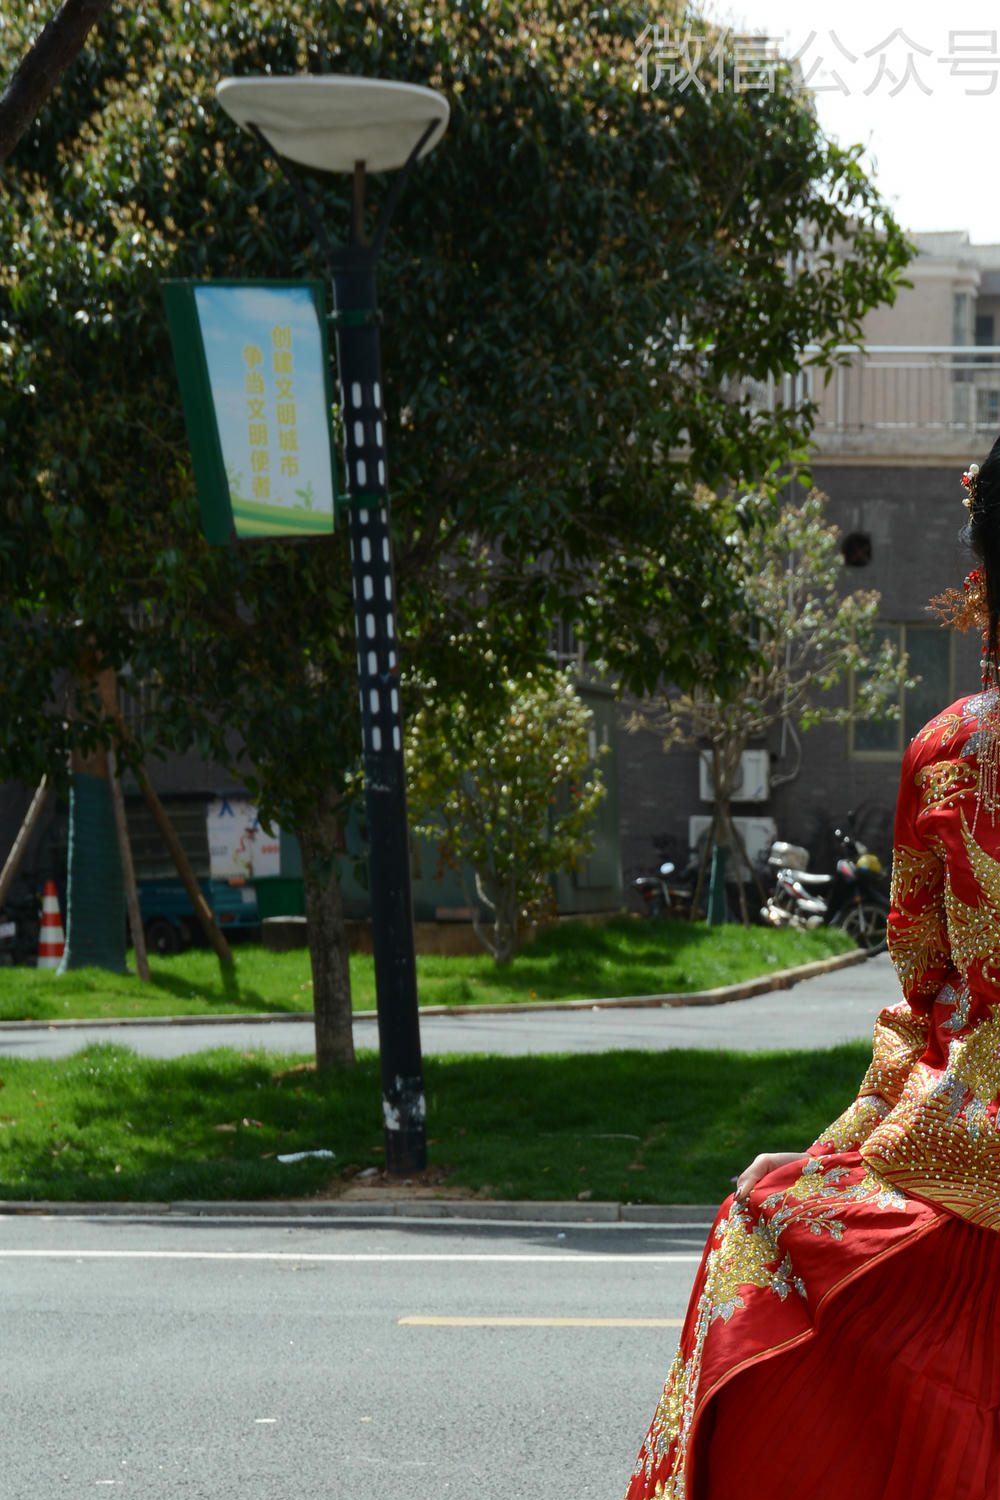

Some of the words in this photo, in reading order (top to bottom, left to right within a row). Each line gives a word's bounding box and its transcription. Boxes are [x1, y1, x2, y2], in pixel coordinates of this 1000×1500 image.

[242, 343, 271, 499] 争当文明使者
[271, 325, 299, 478] 创建文明城市
